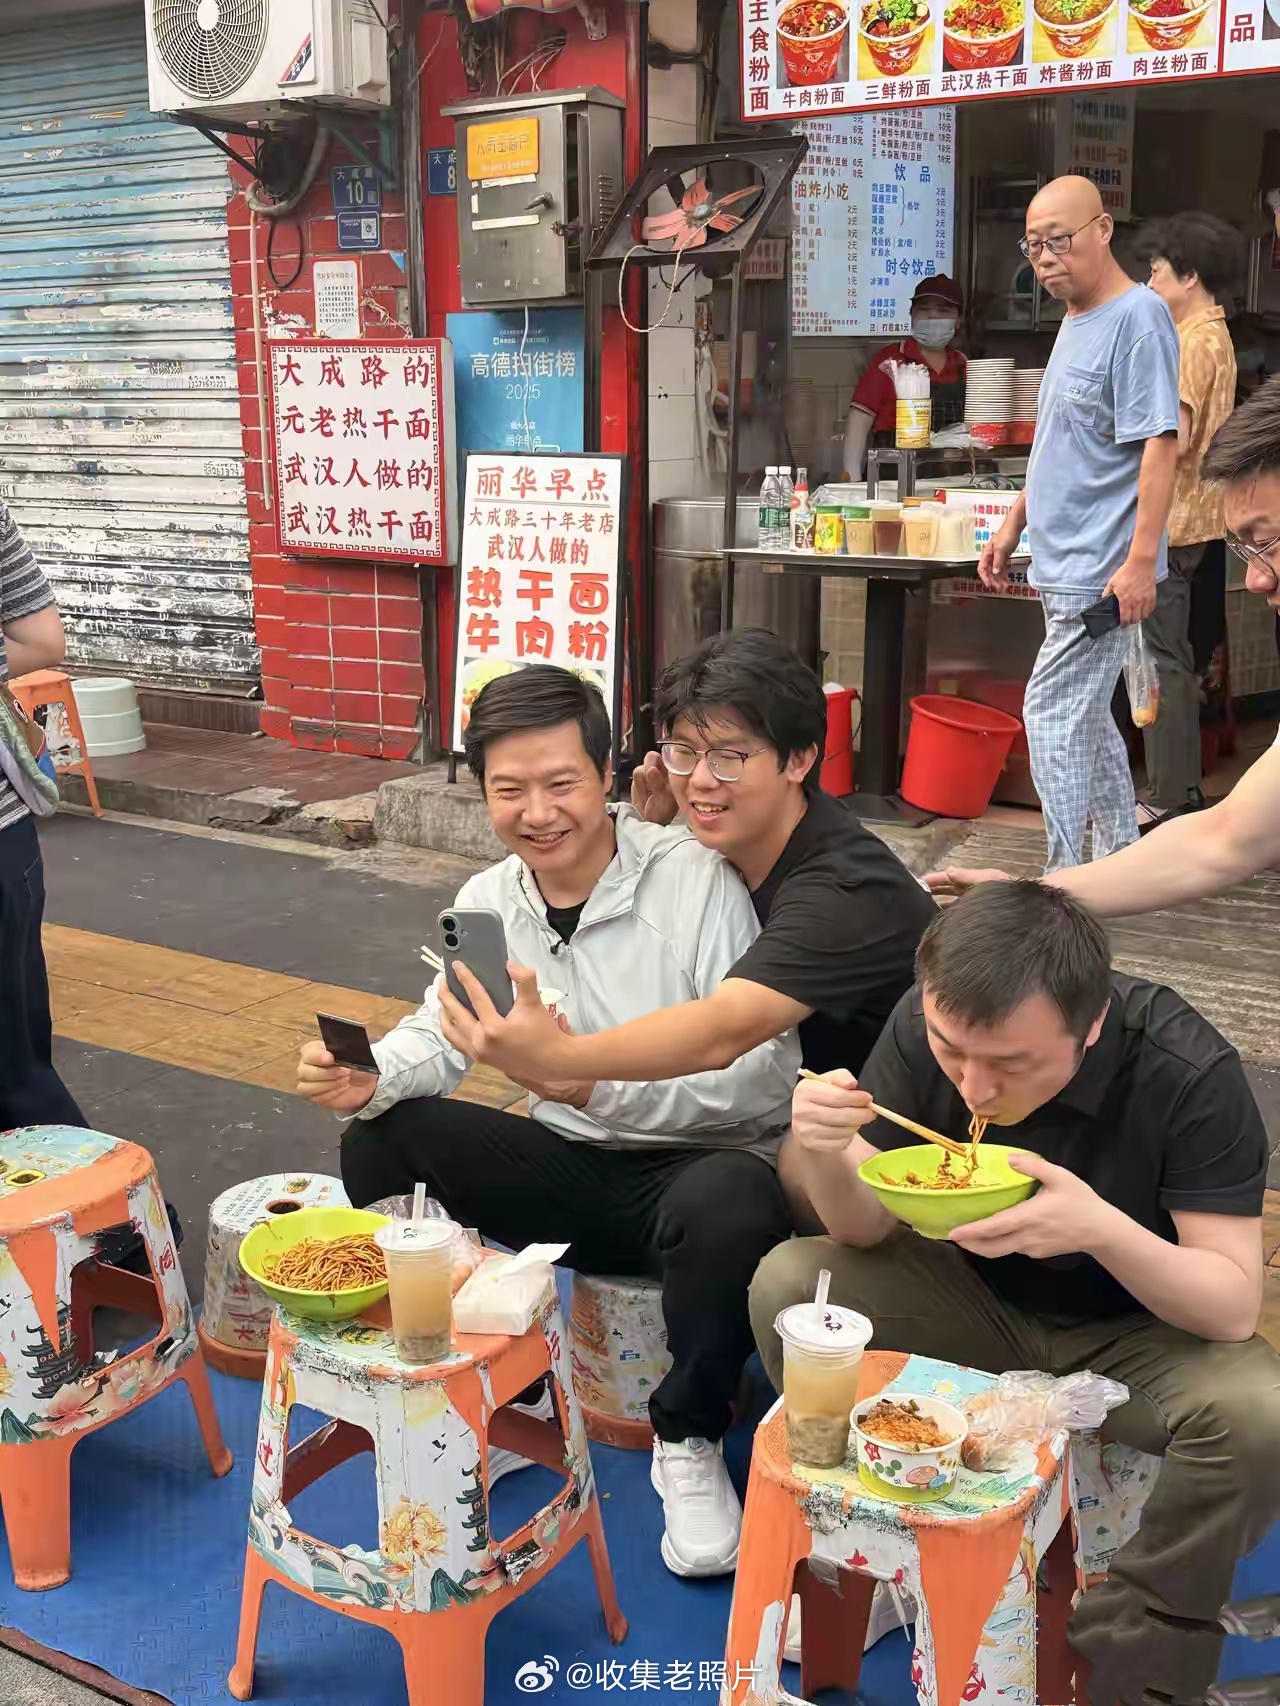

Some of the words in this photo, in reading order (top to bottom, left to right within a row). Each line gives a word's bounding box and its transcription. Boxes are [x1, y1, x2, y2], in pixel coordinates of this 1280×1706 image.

[1230, 13, 1255, 43] 品
[1040, 60, 1113, 83] 炸酱粉面
[1133, 52, 1209, 76] 肉丝粉面
[865, 79, 931, 101] 三鲜粉面
[941, 67, 1029, 92] 武汉热干面
[782, 86, 845, 108] 牛肉粉面
[895, 163, 930, 183] 饮品
[795, 181, 849, 199] 油炸小吃
[886, 258, 936, 275] 时令饮品
[279, 354, 430, 389] 大成路的
[470, 351, 576, 378] 高德扫街榜
[281, 405, 430, 440] 元老热干面
[284, 452, 433, 491] 武汉人做的
[477, 466, 609, 502] 丽华早点
[287, 501, 433, 542] 武汉热干面
[468, 506, 614, 535] 大成路三十年老店
[488, 533, 589, 566] 武汉人做的
[466, 566, 609, 615] 热干面
[466, 612, 609, 662] 牛肉粉
